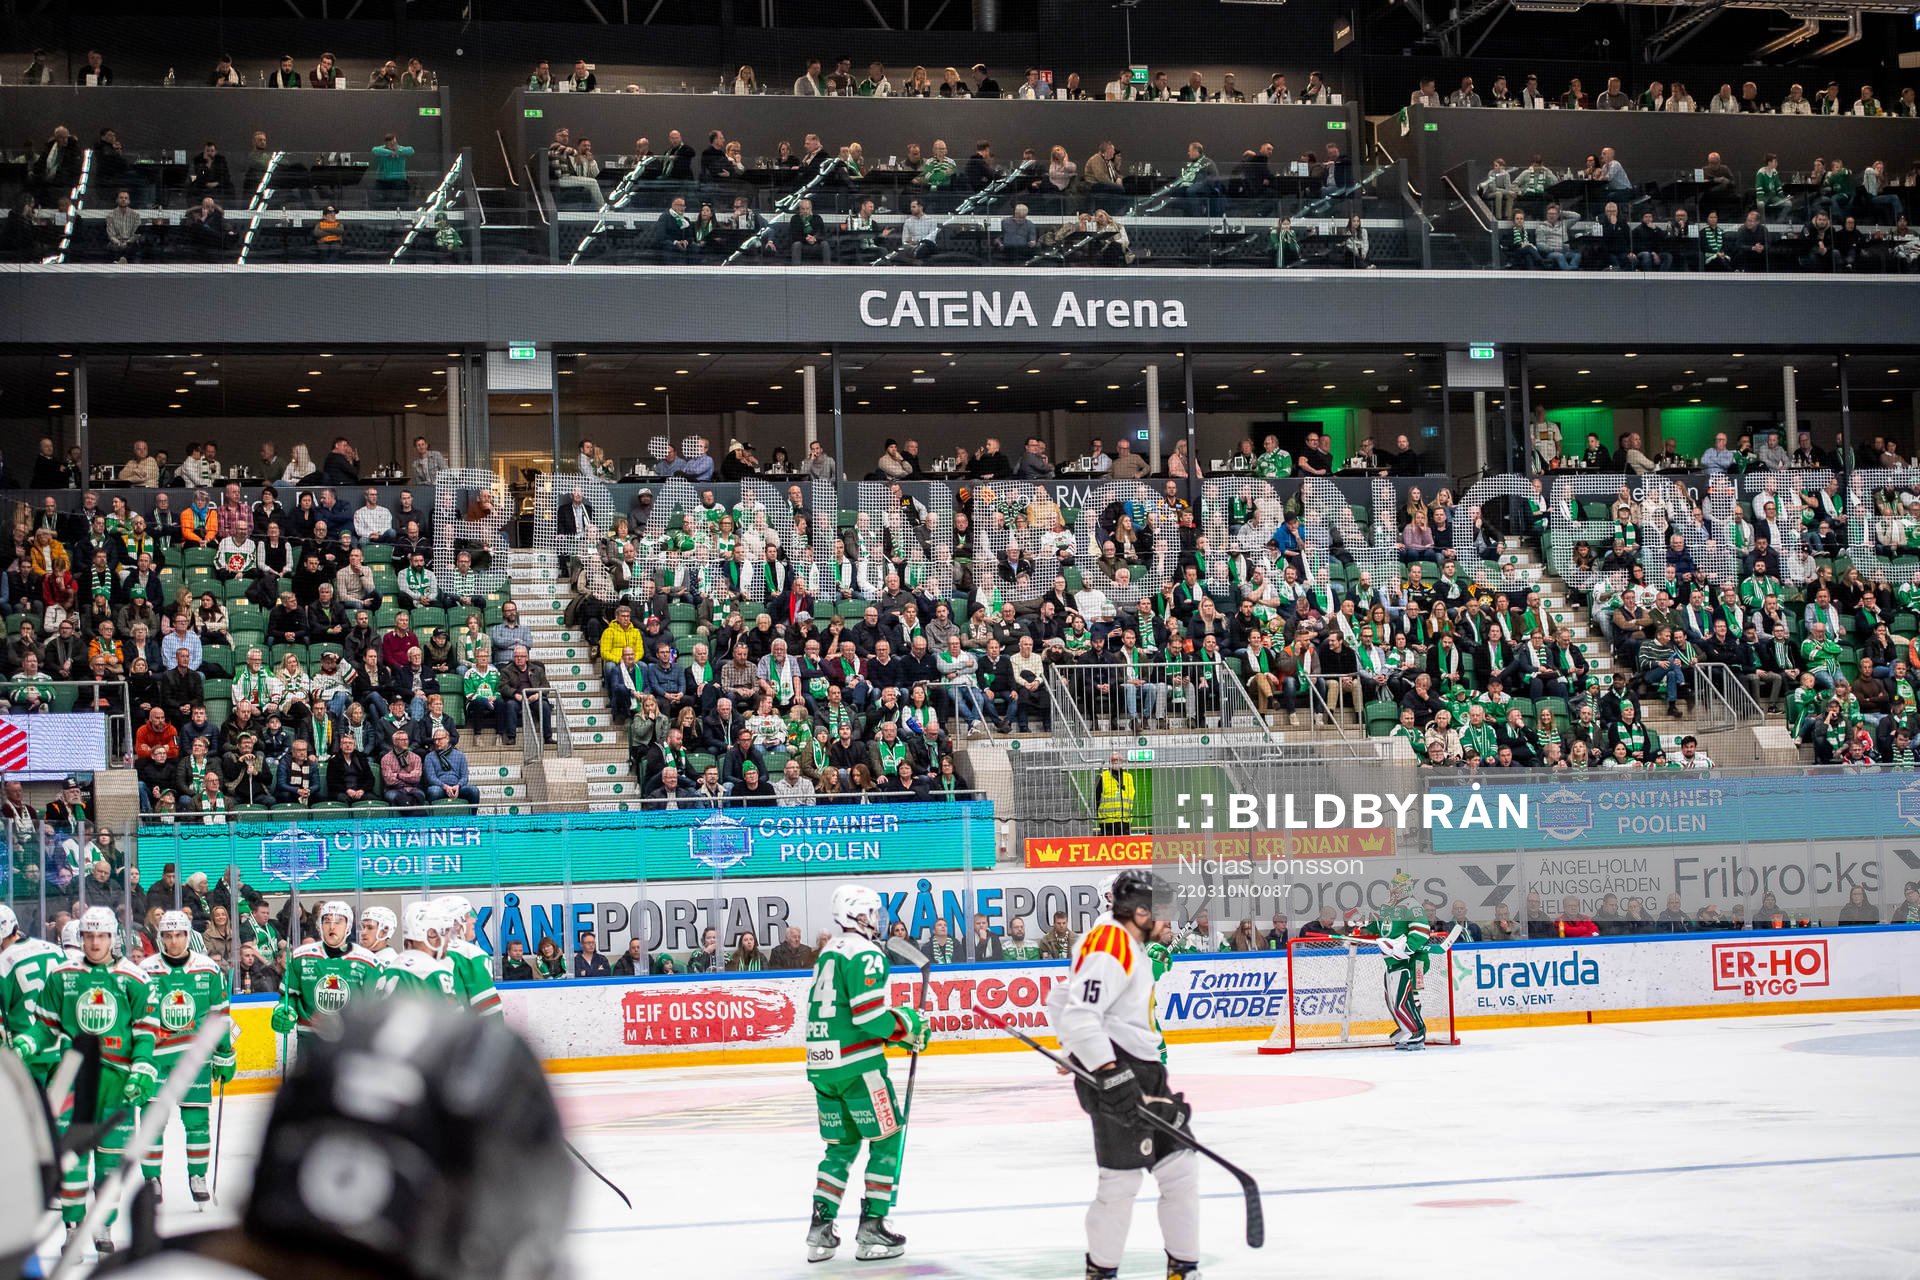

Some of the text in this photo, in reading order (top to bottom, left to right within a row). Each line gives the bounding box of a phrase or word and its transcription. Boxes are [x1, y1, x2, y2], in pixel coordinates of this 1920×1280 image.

[859, 290, 1188, 328] CATENA Arena
[1598, 790, 1723, 810] CONTAINER
[759, 814, 899, 838] CONTAINER
[1617, 814, 1707, 834] POOLEN
[780, 841, 881, 863] POOLEN
[1068, 834, 1350, 863] FLAGGFABRIKEN KRONAN
[361, 855, 462, 876] POOLEN
[1540, 857, 1647, 876] ÄNGELHOLM
[1674, 851, 1881, 900] Fribrocks
[1222, 865, 1447, 918] Fribrocs
[1528, 874, 1661, 897] KUNGSGÅRDEN
[475, 892, 790, 957] KÅNEPORTAR
[862, 954, 884, 976] 24
[1475, 950, 1600, 990] bravida
[1720, 948, 1821, 980] ER-HO
[808, 958, 837, 1018] 4
[1083, 978, 1102, 1004] 15
[1190, 970, 1278, 994] Tommy
[1744, 979, 1798, 996] BYGG
[318, 989, 345, 1009] RÖGLE
[891, 976, 1069, 1012] FLYTGOL
[1477, 996, 1497, 1008] EL,
[1499, 995, 1519, 1008] VS,
[82, 1006, 112, 1026] RÖGLE
[165, 1008, 192, 1026] RÖGLE
[626, 1000, 755, 1023] LEIF OLSSONS
[730, 1024, 754, 1037] AB
